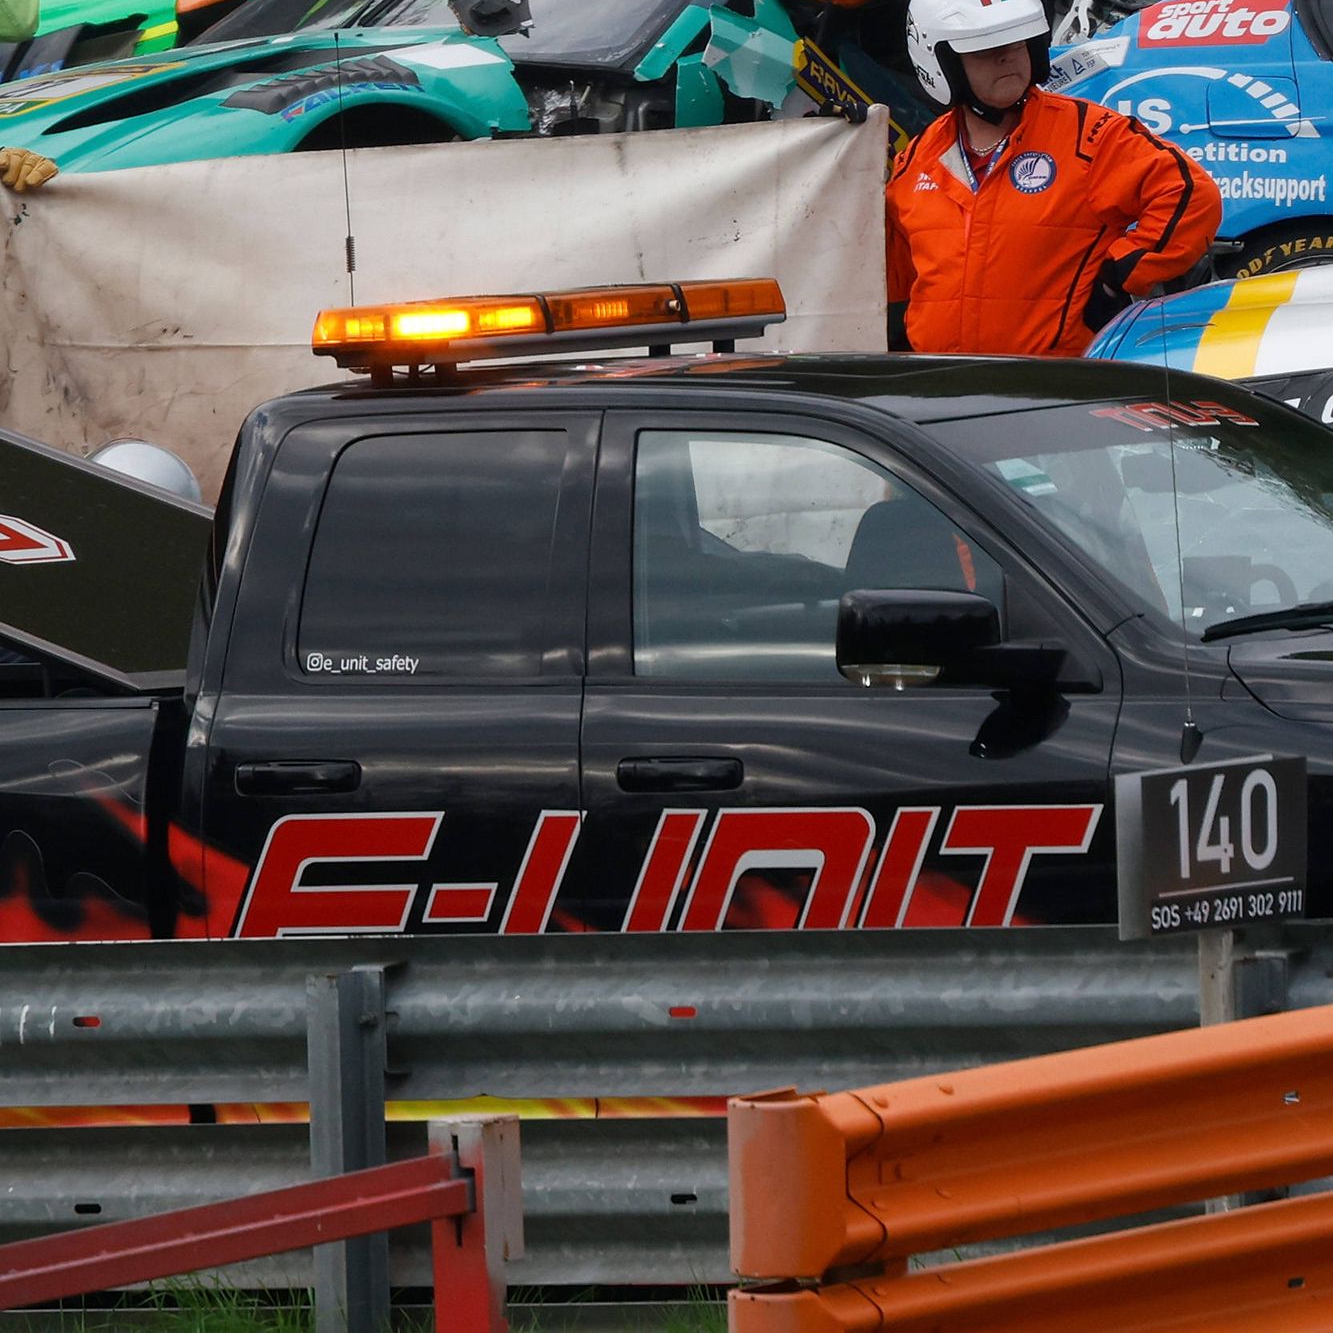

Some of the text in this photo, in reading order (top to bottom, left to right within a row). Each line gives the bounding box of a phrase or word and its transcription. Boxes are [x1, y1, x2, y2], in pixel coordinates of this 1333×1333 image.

[1147, 9, 1291, 40] auto
[323, 653, 420, 674] e_unit_safety
[1169, 768, 1278, 879] 140
[1151, 889, 1303, 930] SOS +49 2691 302 9111
